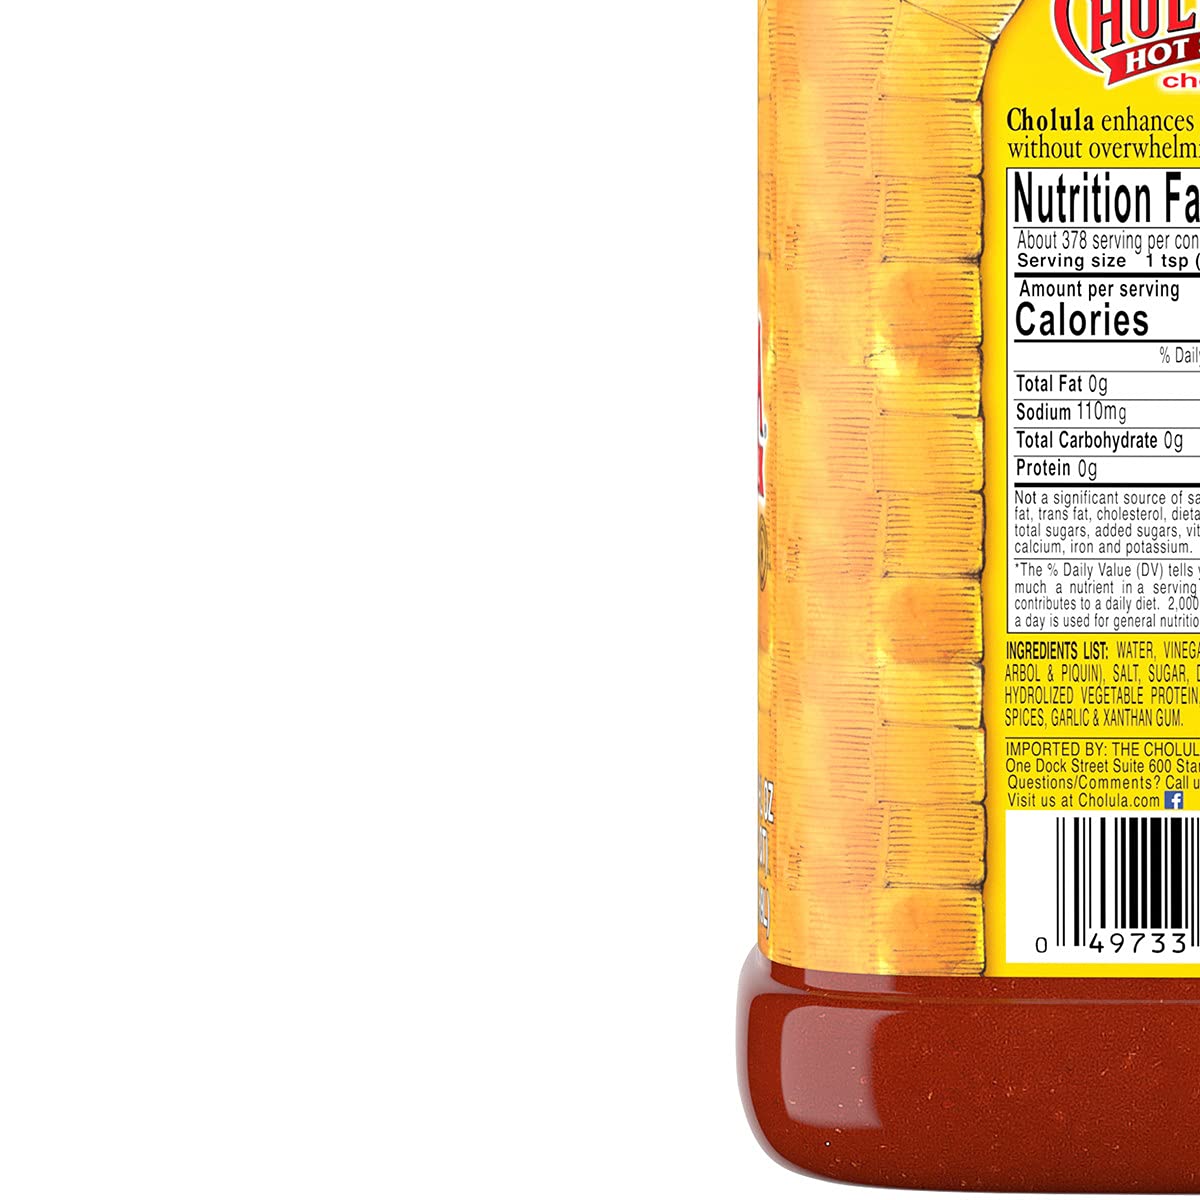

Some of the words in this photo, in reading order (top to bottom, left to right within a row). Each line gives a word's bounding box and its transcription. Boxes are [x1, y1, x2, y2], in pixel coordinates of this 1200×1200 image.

[1126, 38, 1189, 74] HOT
[1007, 107, 1094, 131] Cholula
[1102, 106, 1194, 131] enhances
[1008, 134, 1082, 158] without
[1015, 172, 1150, 223] Nutrition
[1017, 230, 1057, 249] About
[1062, 230, 1087, 249] 378
[1093, 230, 1141, 254] serving
[1148, 234, 1169, 253] per
[1018, 253, 1083, 270] Serving
[1092, 253, 1126, 267] size
[1146, 254, 1153, 267] 1
[1161, 254, 1188, 270] tsp
[1020, 280, 1082, 297] Amount
[1089, 284, 1113, 301] per
[1120, 280, 1179, 301] serving
[1016, 302, 1148, 336] Calories
[1016, 374, 1052, 392] Total
[1060, 375, 1082, 392] Fat
[1089, 374, 1107, 396] 0g
[1017, 403, 1070, 420] Sodium
[1078, 400, 1125, 424] 110mg
[1017, 431, 1052, 448] Total
[1059, 431, 1157, 453] Carbohydrate
[1164, 431, 1182, 452] 0g
[1017, 459, 1070, 476] Protein
[1079, 459, 1096, 481] 0g
[1015, 490, 1036, 504] Not
[1054, 490, 1118, 507] significant
[1124, 494, 1165, 504] source
[1015, 506, 1033, 520] fat,
[1039, 506, 1069, 520] trans
[1073, 506, 1091, 522] fat,
[1097, 507, 1166, 520] cholesterol,
[1015, 523, 1042, 537] total
[1046, 526, 1089, 540] sugars,
[1095, 523, 1131, 537] added
[1137, 526, 1181, 540] sugars,
[1015, 539, 1065, 555] calcium,
[1126, 539, 1192, 556] potassium.
[1064, 562, 1093, 580] Daily
[1098, 563, 1131, 577] Value
[1137, 563, 1163, 579] (DV)
[1169, 563, 1193, 577] tells
[1015, 580, 1046, 593] much
[1070, 580, 1113, 594] nutrient
[1153, 580, 1196, 597] serving
[1015, 596, 1076, 610] contributes
[1106, 596, 1131, 612] daily
[1136, 596, 1159, 610] diet.
[1169, 596, 1199, 610] 2,000
[1064, 613, 1089, 627] used
[1114, 613, 1155, 630] general
[1007, 641, 1078, 660] INGREDIENTS
[1084, 641, 1108, 660] LIST:
[1117, 641, 1156, 659] WATER,
[1005, 663, 1040, 682] ARBOL
[1062, 664, 1105, 684] PIQUIN),
[1113, 664, 1140, 684] SALT,
[1148, 664, 1189, 682] SUGAR,
[1005, 686, 1073, 704] HYDROLIZED
[1081, 685, 1143, 704] VEGETABLE
[1152, 686, 1200, 705] PROTEIN,
[1005, 708, 1047, 729] SPICES,
[1051, 708, 1089, 726] GARLIC
[1104, 708, 1152, 726] XANTHAN
[1156, 708, 1183, 727] GUM.
[1007, 741, 1080, 756] IMPORTED
[1086, 742, 1107, 756] BY:
[1112, 742, 1139, 756] THE
[1006, 758, 1031, 772] One
[1036, 758, 1066, 773] Dock
[1071, 758, 1108, 773] Street
[1113, 758, 1144, 773] Suite
[1149, 759, 1171, 773] 600
[1008, 774, 1160, 789] Questions/Comments?
[1166, 775, 1188, 789] Call
[1008, 793, 1035, 807] Visit
[1041, 796, 1055, 807] us
[1061, 794, 1073, 807] at
[1079, 792, 1159, 807] Cholula.com
[1036, 937, 1047, 953] 0
[1089, 933, 1185, 953] 49733
